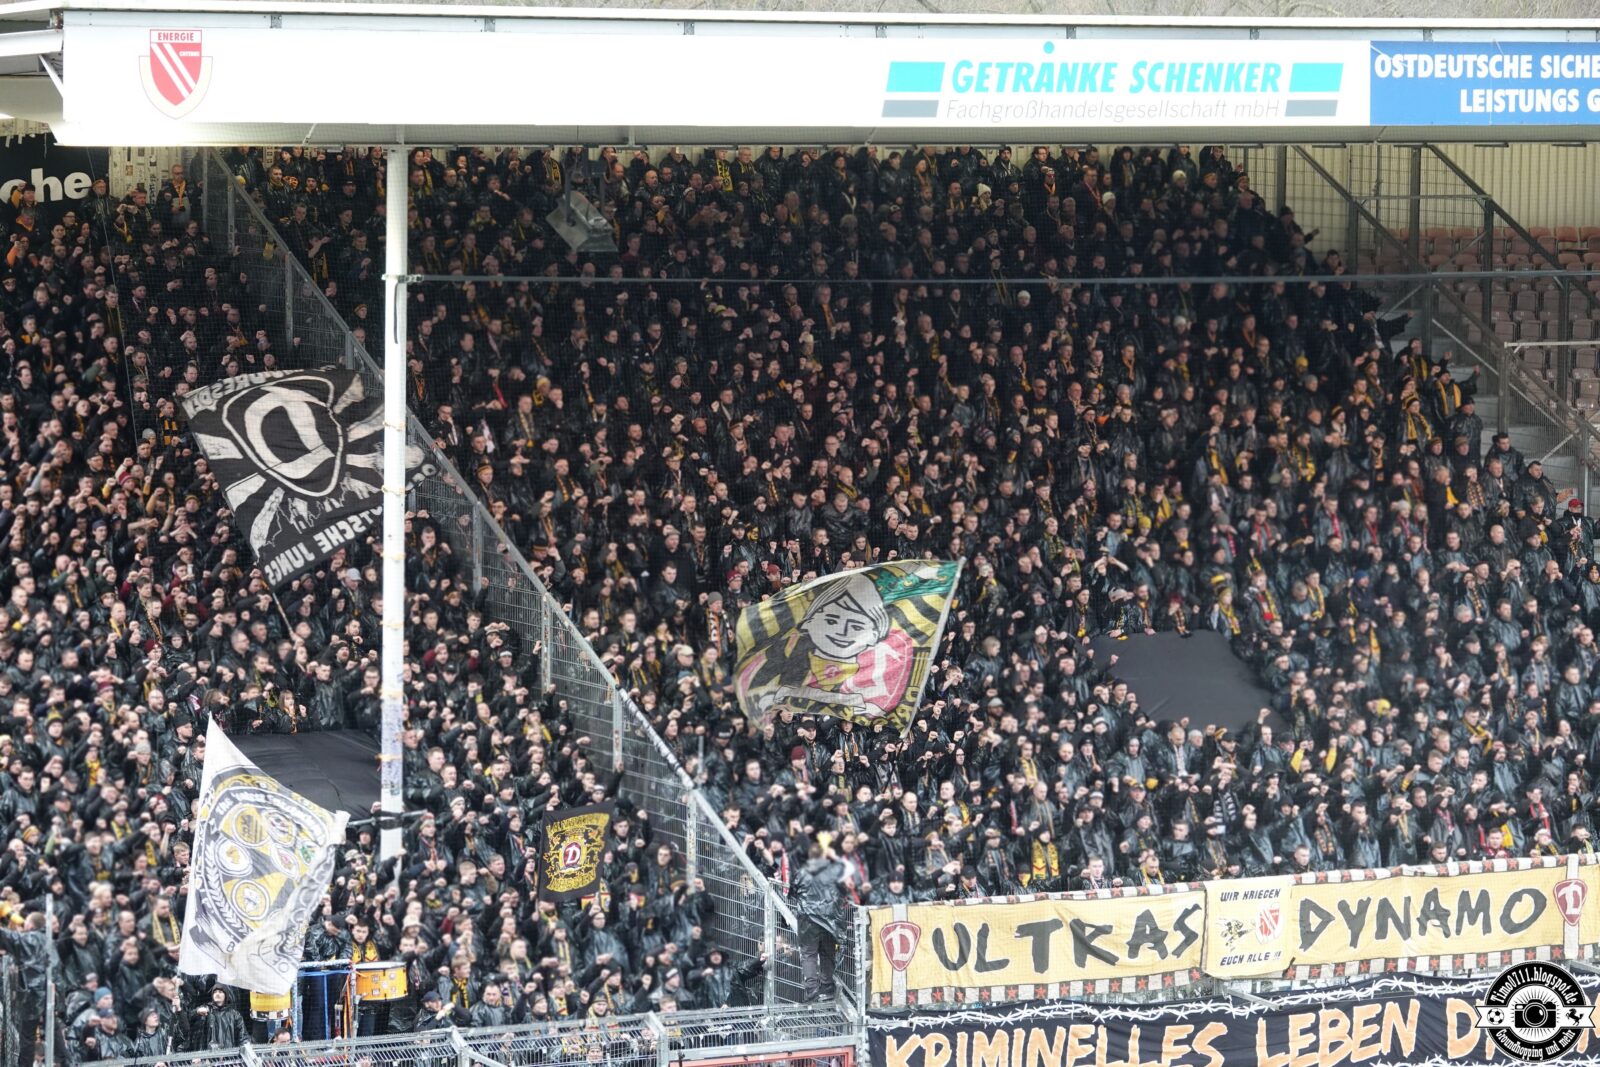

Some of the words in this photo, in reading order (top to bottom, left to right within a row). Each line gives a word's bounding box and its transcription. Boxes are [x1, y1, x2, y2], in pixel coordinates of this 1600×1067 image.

[158, 32, 194, 41] ENERGIE
[1129, 60, 1282, 94] SCHENKER
[1374, 54, 1533, 78] OSTDEUTSCHE
[1540, 54, 1600, 78] SICHE
[947, 99, 1227, 123] Fachgroßhandelsgesellschaft
[1234, 100, 1280, 118] mbH
[1460, 88, 1580, 112] LEISTUNGS
[1220, 891, 1240, 902] WIR
[1242, 888, 1281, 900] KRIEGEN
[1299, 887, 1548, 952] DYNAMO
[931, 903, 1202, 974] ULTRAS
[1220, 954, 1245, 966] EUCH
[1246, 951, 1271, 963] ALLE
[1255, 1000, 1420, 1067] LEBEN
